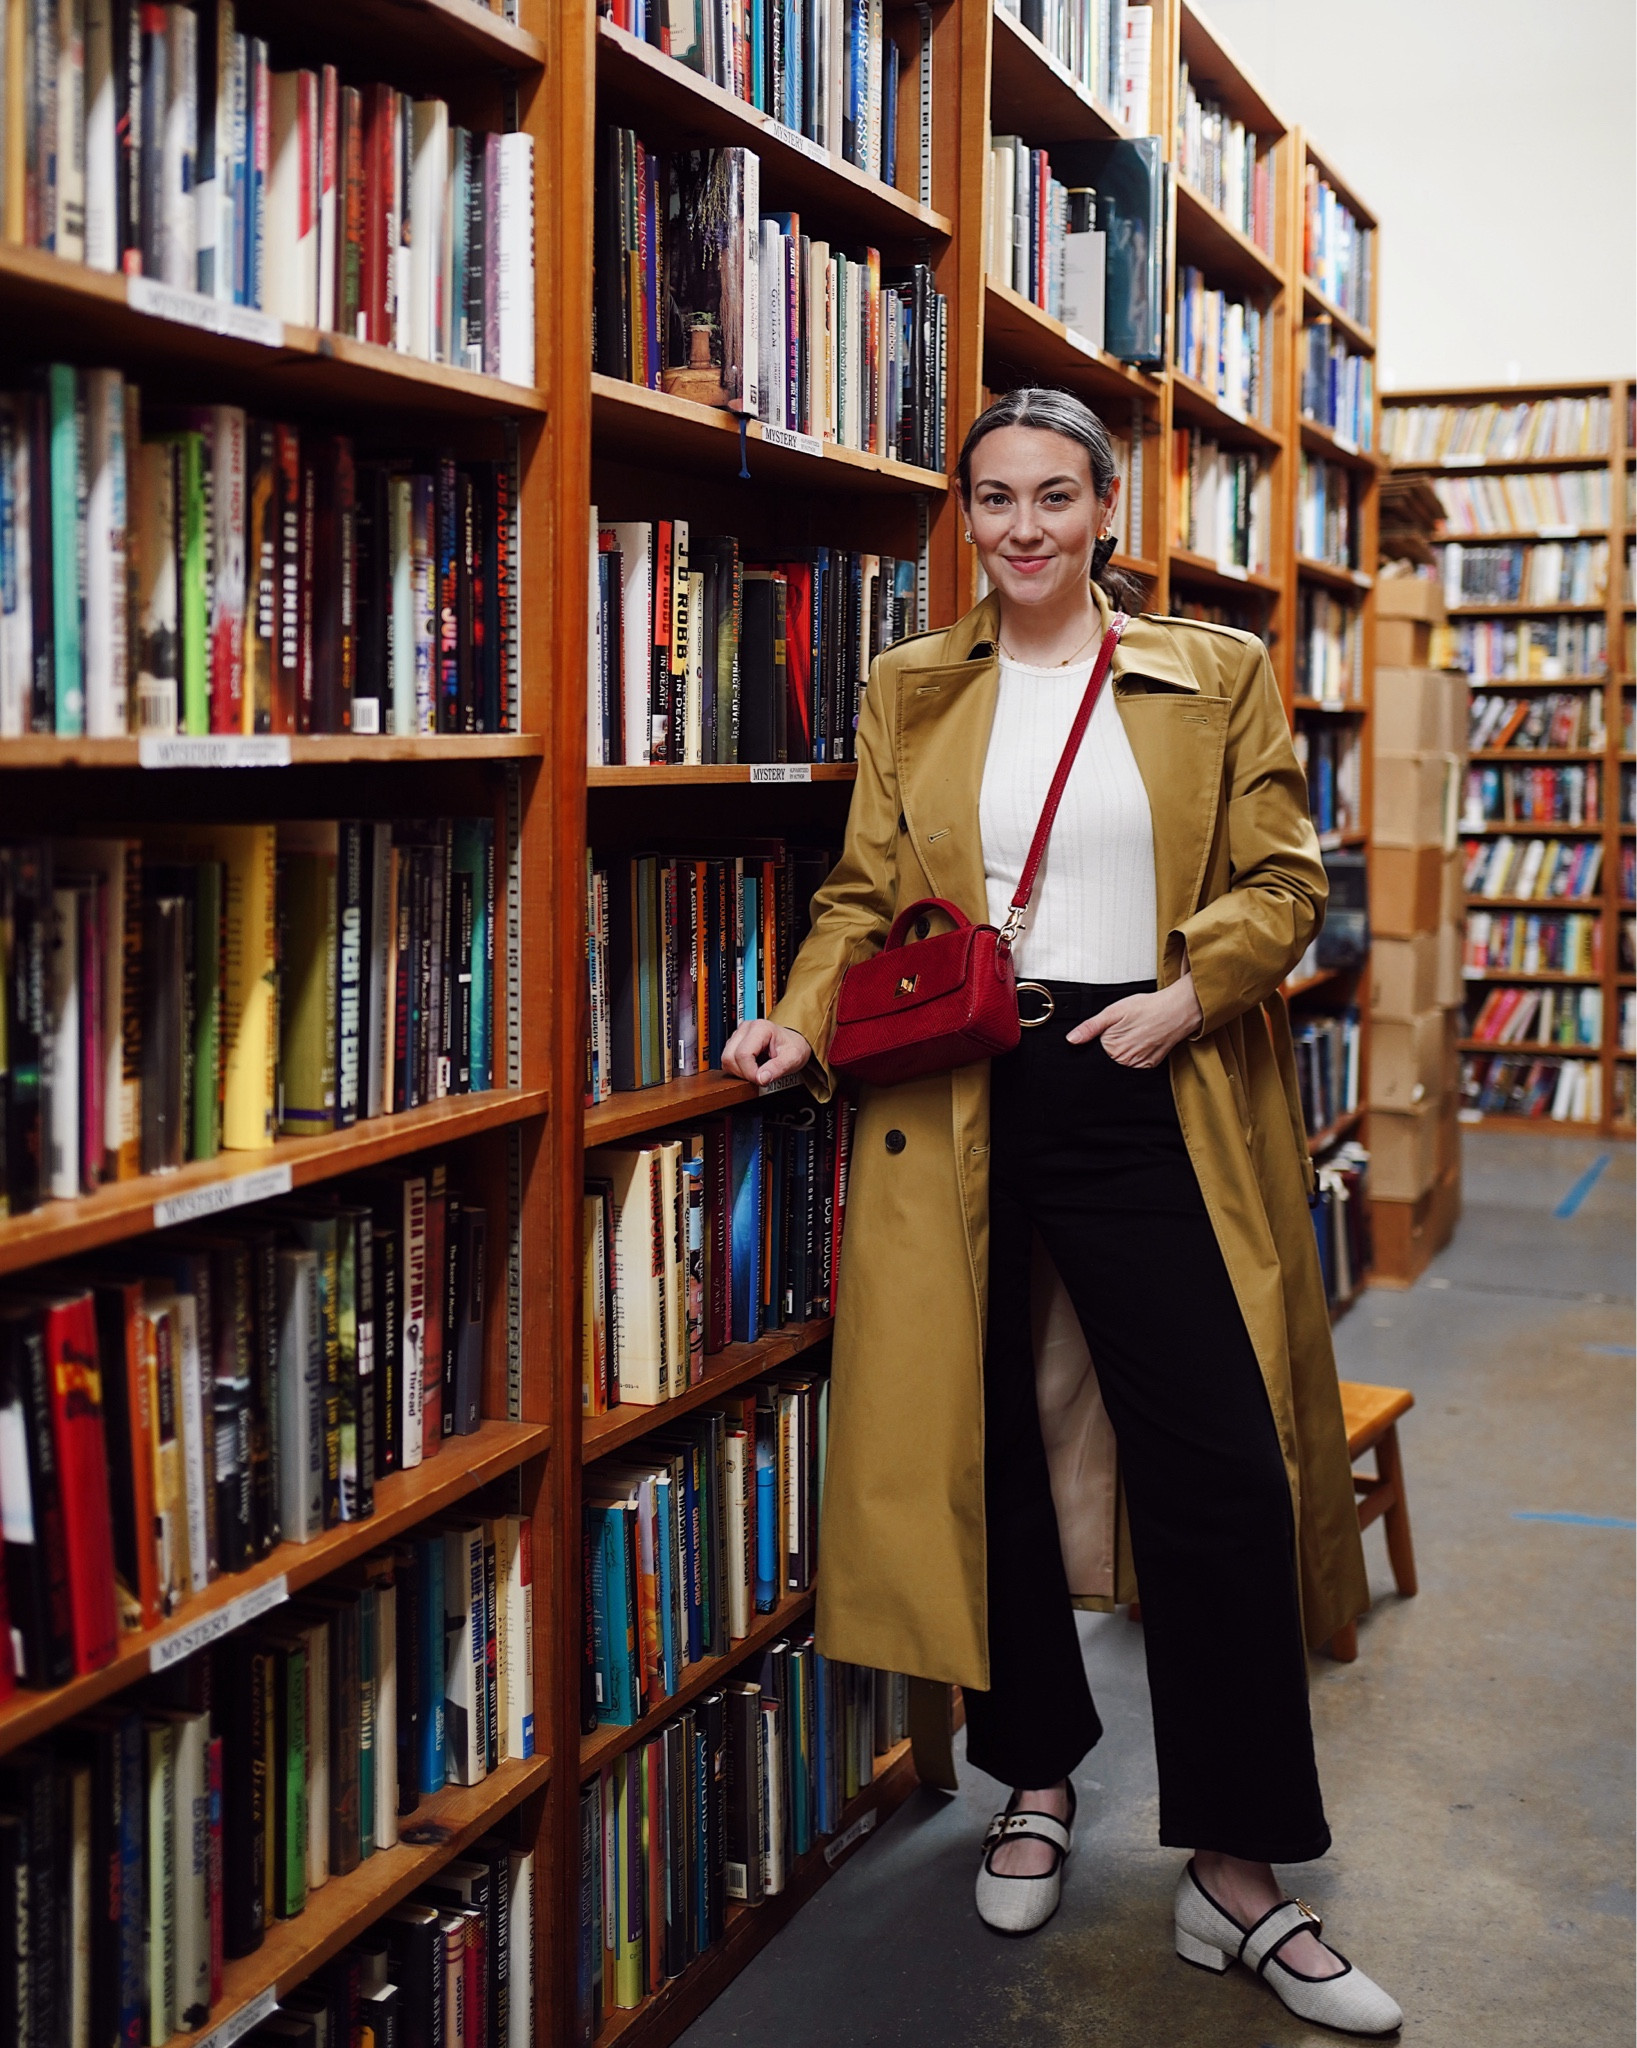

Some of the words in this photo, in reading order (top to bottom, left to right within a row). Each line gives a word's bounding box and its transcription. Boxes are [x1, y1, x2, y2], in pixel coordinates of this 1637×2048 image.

[773, 6, 781, 62] Perish
[873, 12, 881, 86] LOUISE
[773, 68, 781, 118] Twice
[773, 123, 804, 151] MYSTERY
[856, 90, 865, 159] PENNY
[872, 105, 881, 174] PENNY
[637, 147, 646, 205] ANNE
[889, 295, 897, 319] Julian
[889, 320, 897, 362] Rathbone
[230, 417, 242, 475] ANNE
[765, 428, 798, 448] MYSTERY
[230, 482, 242, 534] HOLT
[497, 473, 508, 598] DEADMAN
[677, 542, 688, 560] J.
[677, 566, 688, 584] D.
[283, 564, 298, 668] NUMBERS
[602, 601, 610, 616] Who
[602, 618, 610, 639] Gets
[677, 593, 688, 659] ROBB
[602, 643, 610, 659] the
[659, 655, 667, 667] IN
[231, 663, 242, 699] Not
[602, 662, 610, 717] Apartment?
[659, 670, 667, 707] DEATH
[675, 679, 683, 688] IN
[675, 690, 683, 742] DEATH
[753, 768, 786, 780] MYSTERY
[690, 871, 698, 882] A
[690, 885, 698, 930] Lethal
[342, 907, 361, 981] OVER
[487, 917, 495, 960] BRESLAU
[690, 932, 698, 982] Vintage
[771, 941, 776, 959] OF
[341, 987, 359, 1037] THE
[340, 1038, 358, 1109] EDGE
[826, 1110, 835, 1140] SAW
[717, 1133, 725, 1206] CHARLES
[807, 1140, 815, 1182] MURDER
[807, 1188, 814, 1200] ON
[838, 1162, 849, 1207] TRUMAN
[410, 1187, 423, 1239] LAURA
[717, 1209, 725, 1252] TODD
[824, 1197, 832, 1224] BOB
[448, 1245, 457, 1260] The
[448, 1263, 457, 1284] Scent
[824, 1230, 832, 1288] TRULUCK
[385, 1271, 395, 1294] THE
[410, 1247, 423, 1320] LIPPMAN
[448, 1287, 457, 1296] of
[659, 1277, 667, 1297] JIM
[385, 1302, 395, 1359] DAMAGE
[448, 1298, 457, 1329] Murder
[659, 1300, 667, 1365] THOMPSON
[236, 1327, 249, 1376] LEON
[408, 1371, 417, 1416] Thread
[236, 1408, 249, 1463] Beastly
[326, 1429, 339, 1480] Mason
[236, 1472, 249, 1524] Things
[692, 1507, 701, 1549] CHARLES
[470, 1539, 482, 1566] THE
[487, 1554, 496, 1568] M.
[470, 1567, 482, 1599] BLUE
[487, 1571, 496, 1581] J.
[692, 1550, 701, 1606] WILLEFORD
[524, 1589, 533, 1625] Bulldog
[585, 1600, 592, 1612] of
[159, 1612, 232, 1661] MYSTERY
[472, 1601, 484, 1663] HAMMER
[524, 1626, 533, 1676] Drummond
[585, 1635, 594, 1665] Tiger
[475, 1665, 485, 1692] ROSS
[489, 1680, 497, 1712] WHITE
[476, 1694, 486, 1756] MACDONALD
[489, 1714, 497, 1741] HEAT
[192, 1799, 205, 1818] ED
[192, 1822, 205, 1875] McBAIN
[581, 1824, 591, 1879] HARLAN
[498, 1870, 508, 1946] LIGHTNING
[581, 1882, 591, 1927] COBEN
[433, 1937, 441, 1992] ARCHER
[498, 1952, 508, 1980] ROD
[433, 1997, 441, 2047] MAYOR
[498, 1988, 508, 2027] BRAD
